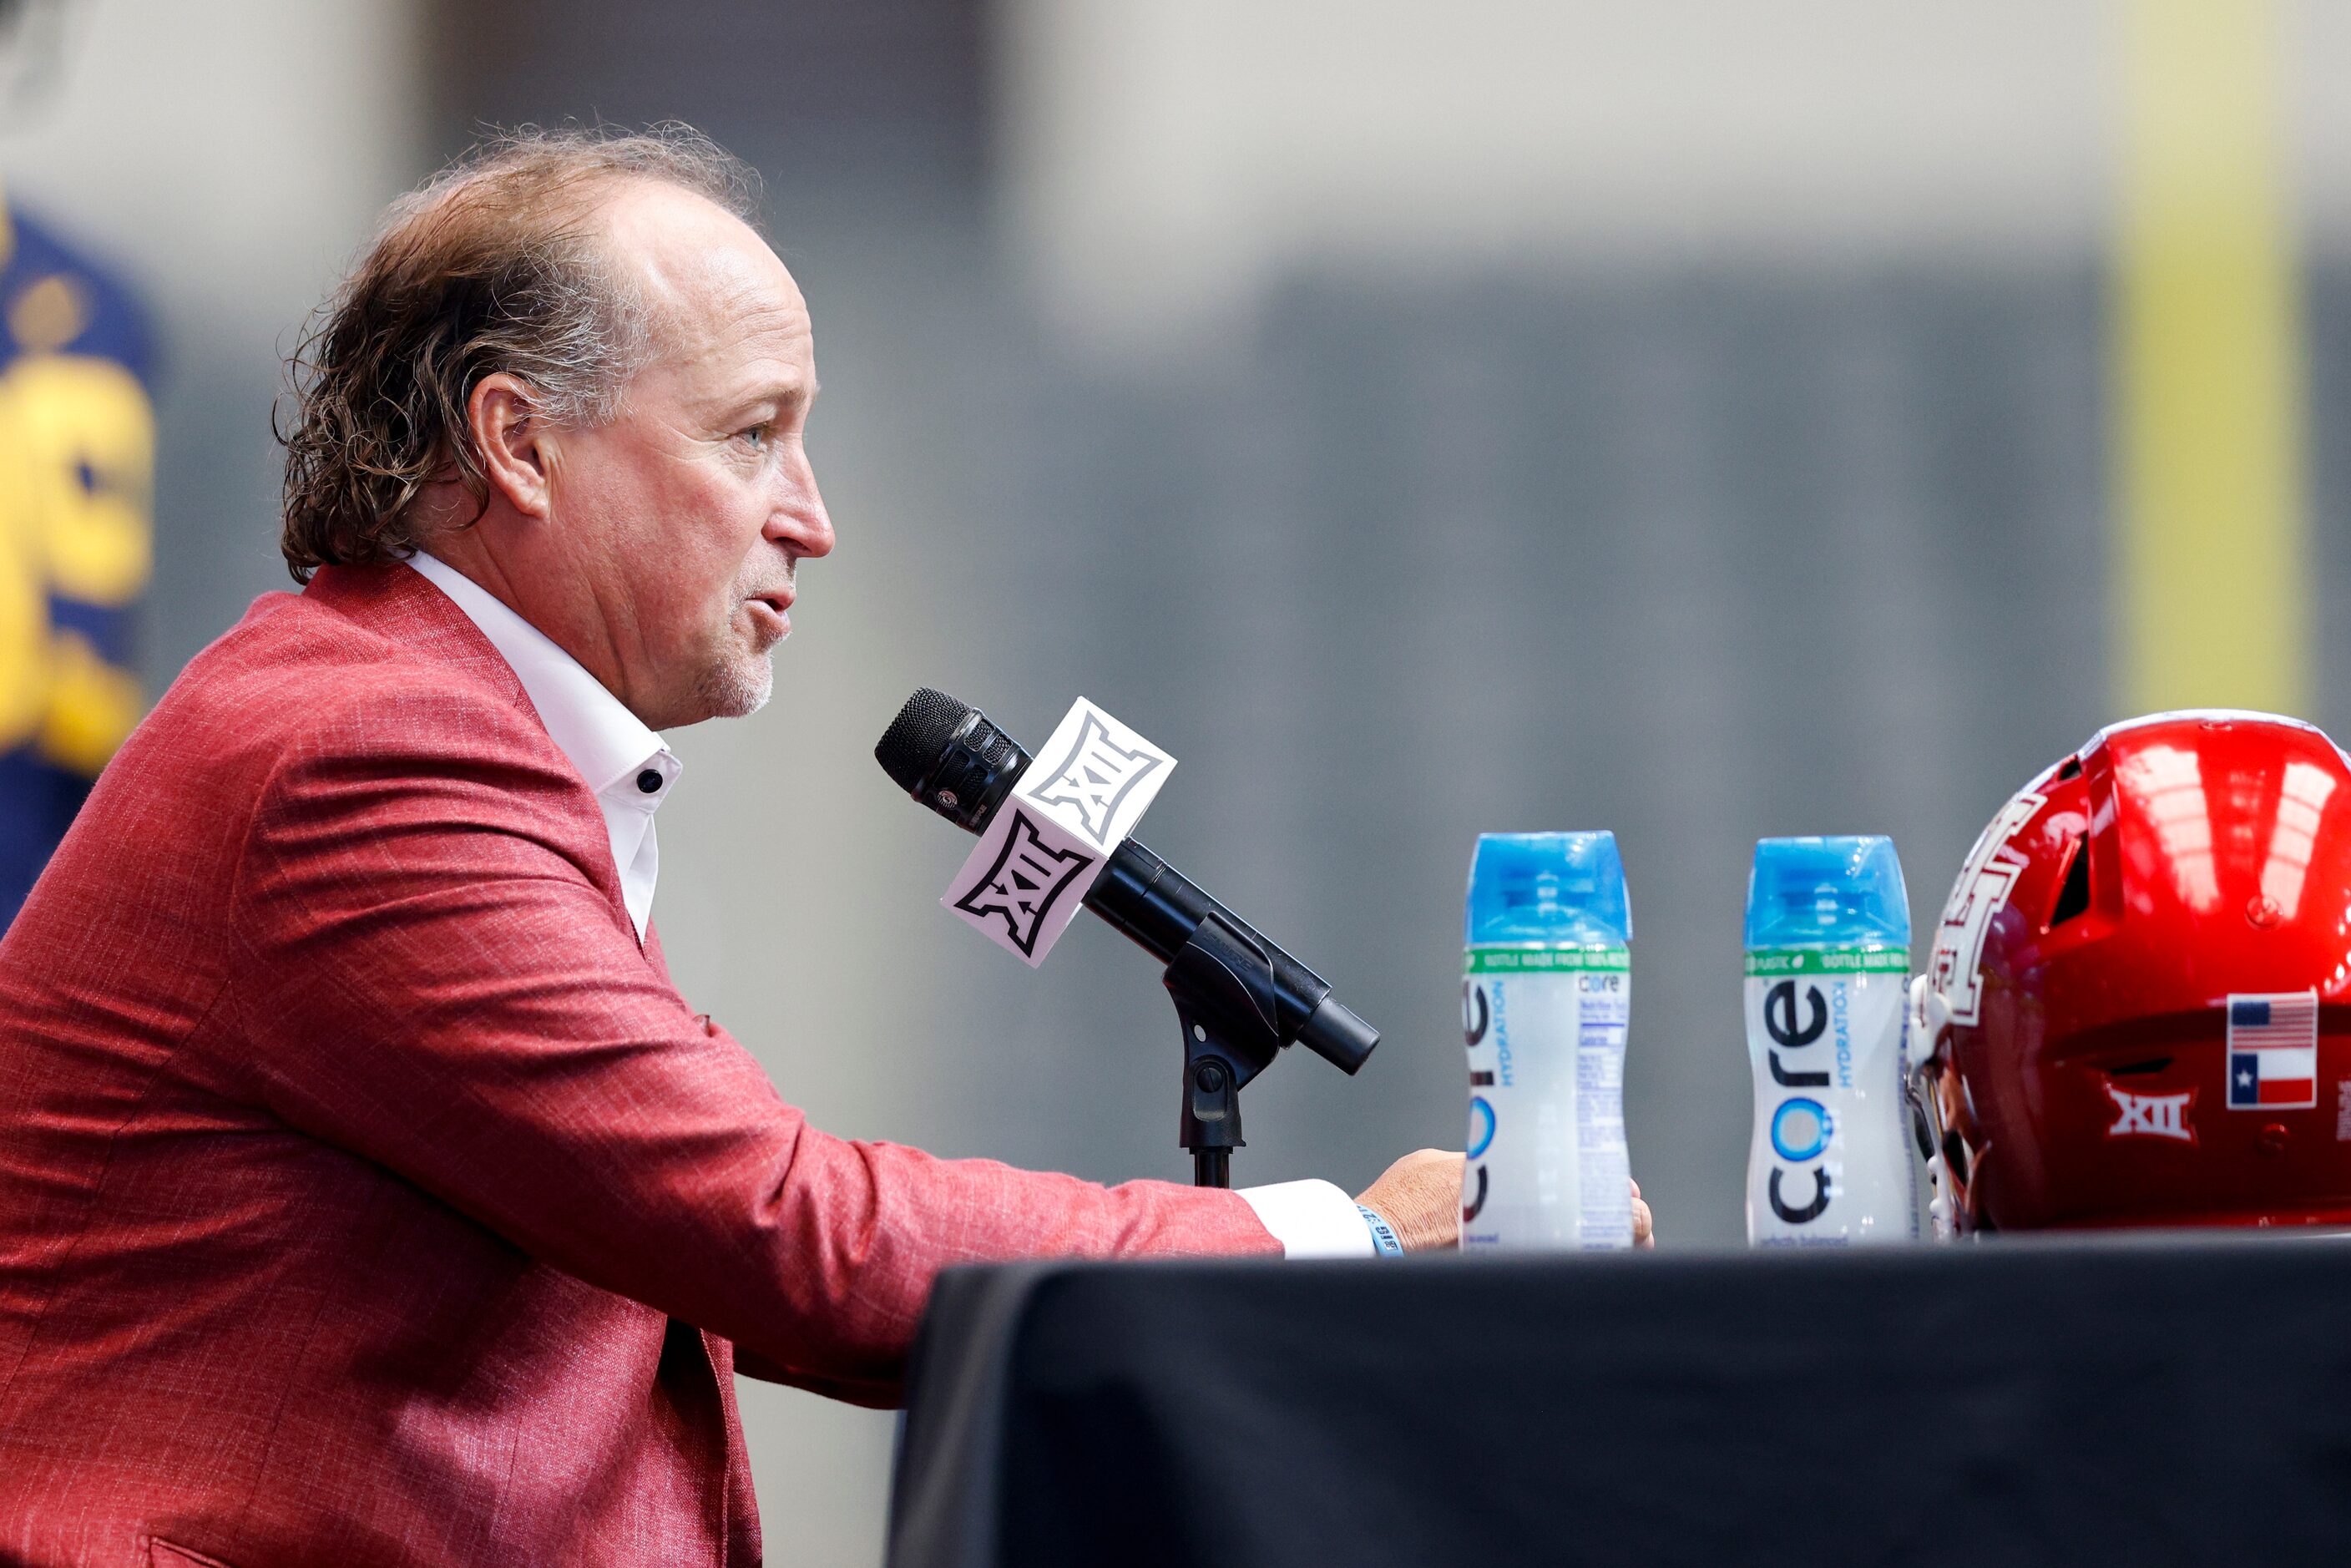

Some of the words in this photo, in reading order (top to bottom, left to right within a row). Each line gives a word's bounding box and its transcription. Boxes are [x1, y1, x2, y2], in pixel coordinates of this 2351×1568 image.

[968, 803, 988, 827] SHURE
[1578, 974, 1620, 993] core
[1492, 980, 1514, 1087] HYDRATION
[1833, 980, 1853, 1088] HYDRATION
[1764, 979, 1834, 1225] core
[2108, 1088, 2192, 1142] XII
